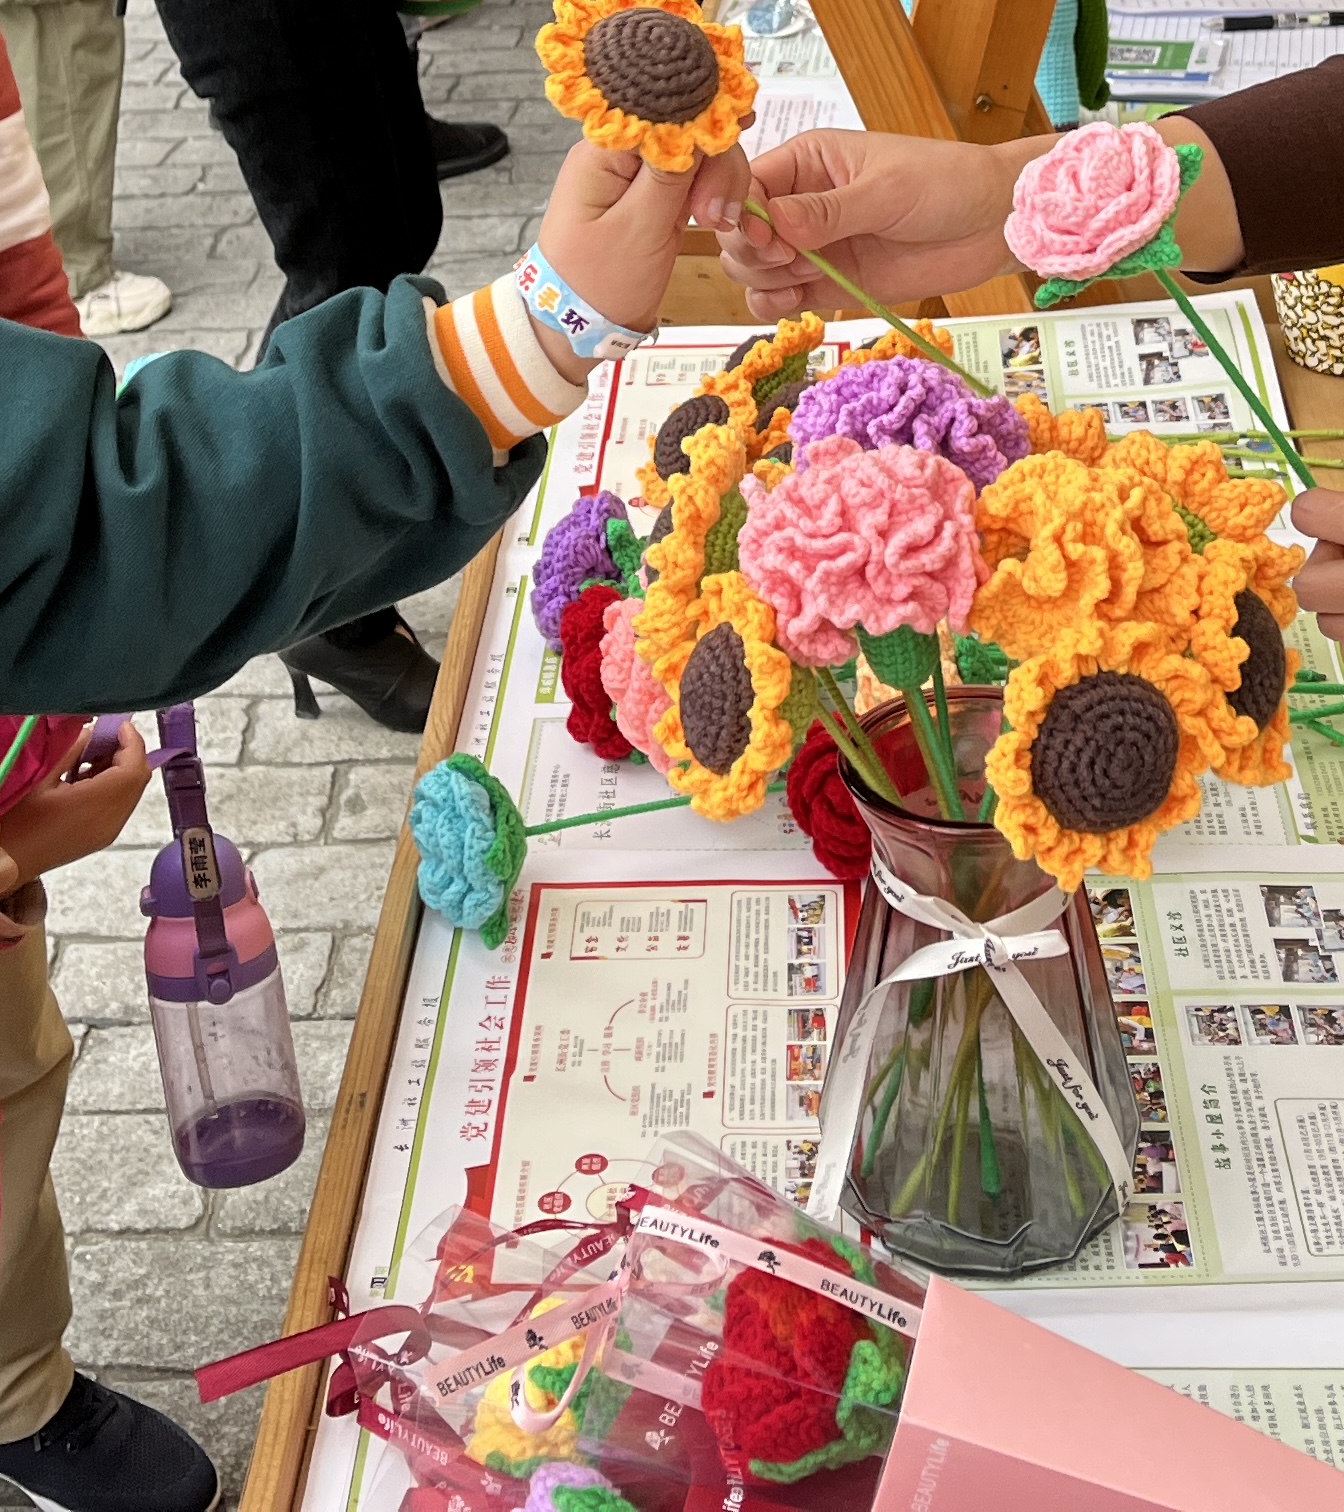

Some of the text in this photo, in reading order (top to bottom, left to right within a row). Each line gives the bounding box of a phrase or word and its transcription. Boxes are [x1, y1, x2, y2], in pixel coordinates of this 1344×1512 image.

[1169, 910, 1190, 958] 社区义诊
[459, 974, 512, 1142] 党建引领社会工作
[1200, 1083, 1232, 1172] 故事小屋简介
[635, 1212, 721, 1250] EAUTYLife
[819, 1277, 908, 1329] BEAUTYLife
[436, 1353, 507, 1398] BEAUTYLife
